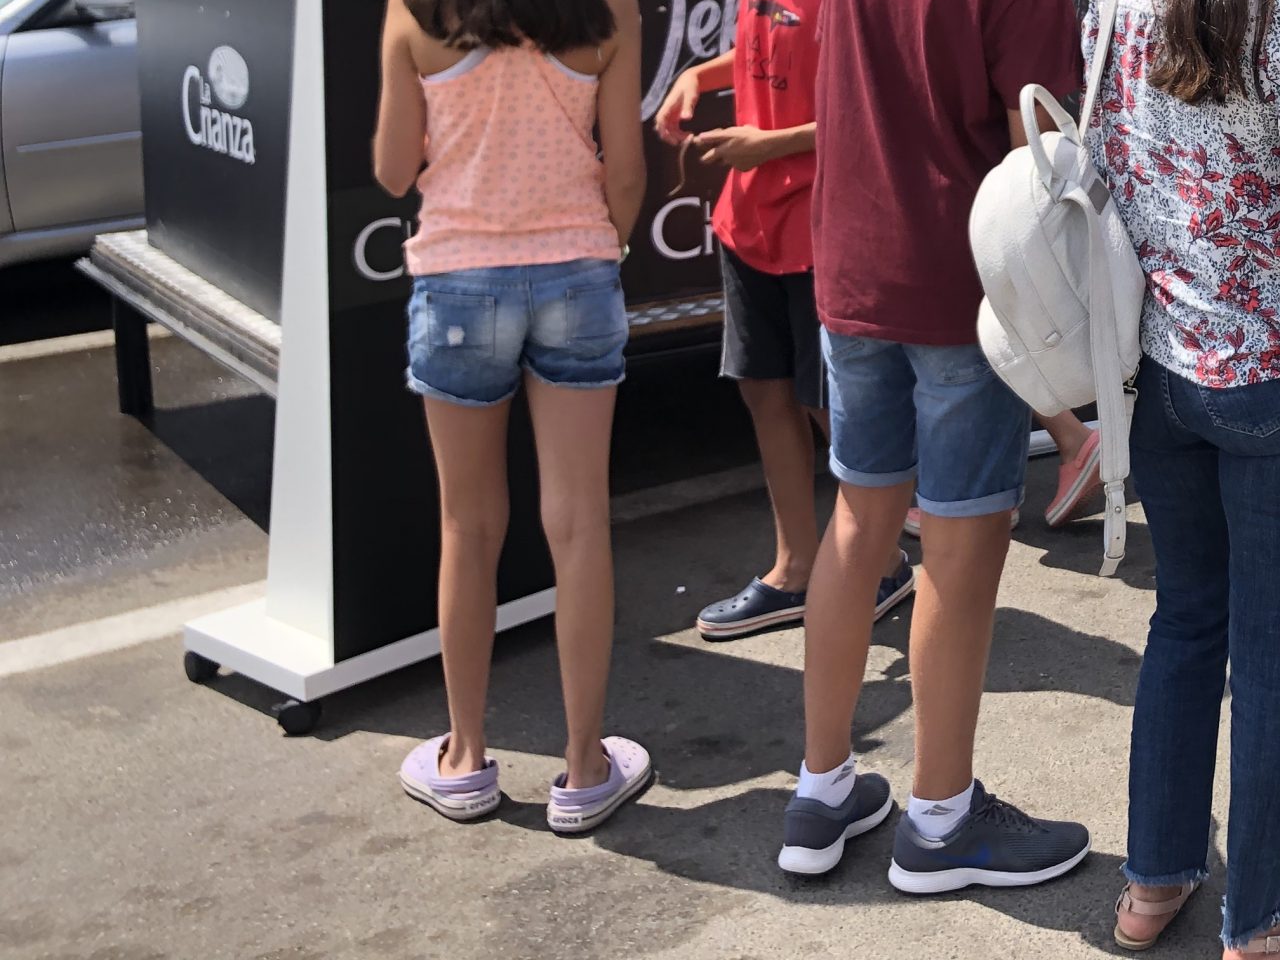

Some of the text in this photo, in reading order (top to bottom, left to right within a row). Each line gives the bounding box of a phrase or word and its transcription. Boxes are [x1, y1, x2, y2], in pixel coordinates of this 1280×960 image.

[200, 75, 211, 105] La
[469, 796, 497, 810] crocs
[552, 817, 580, 825] crocs
